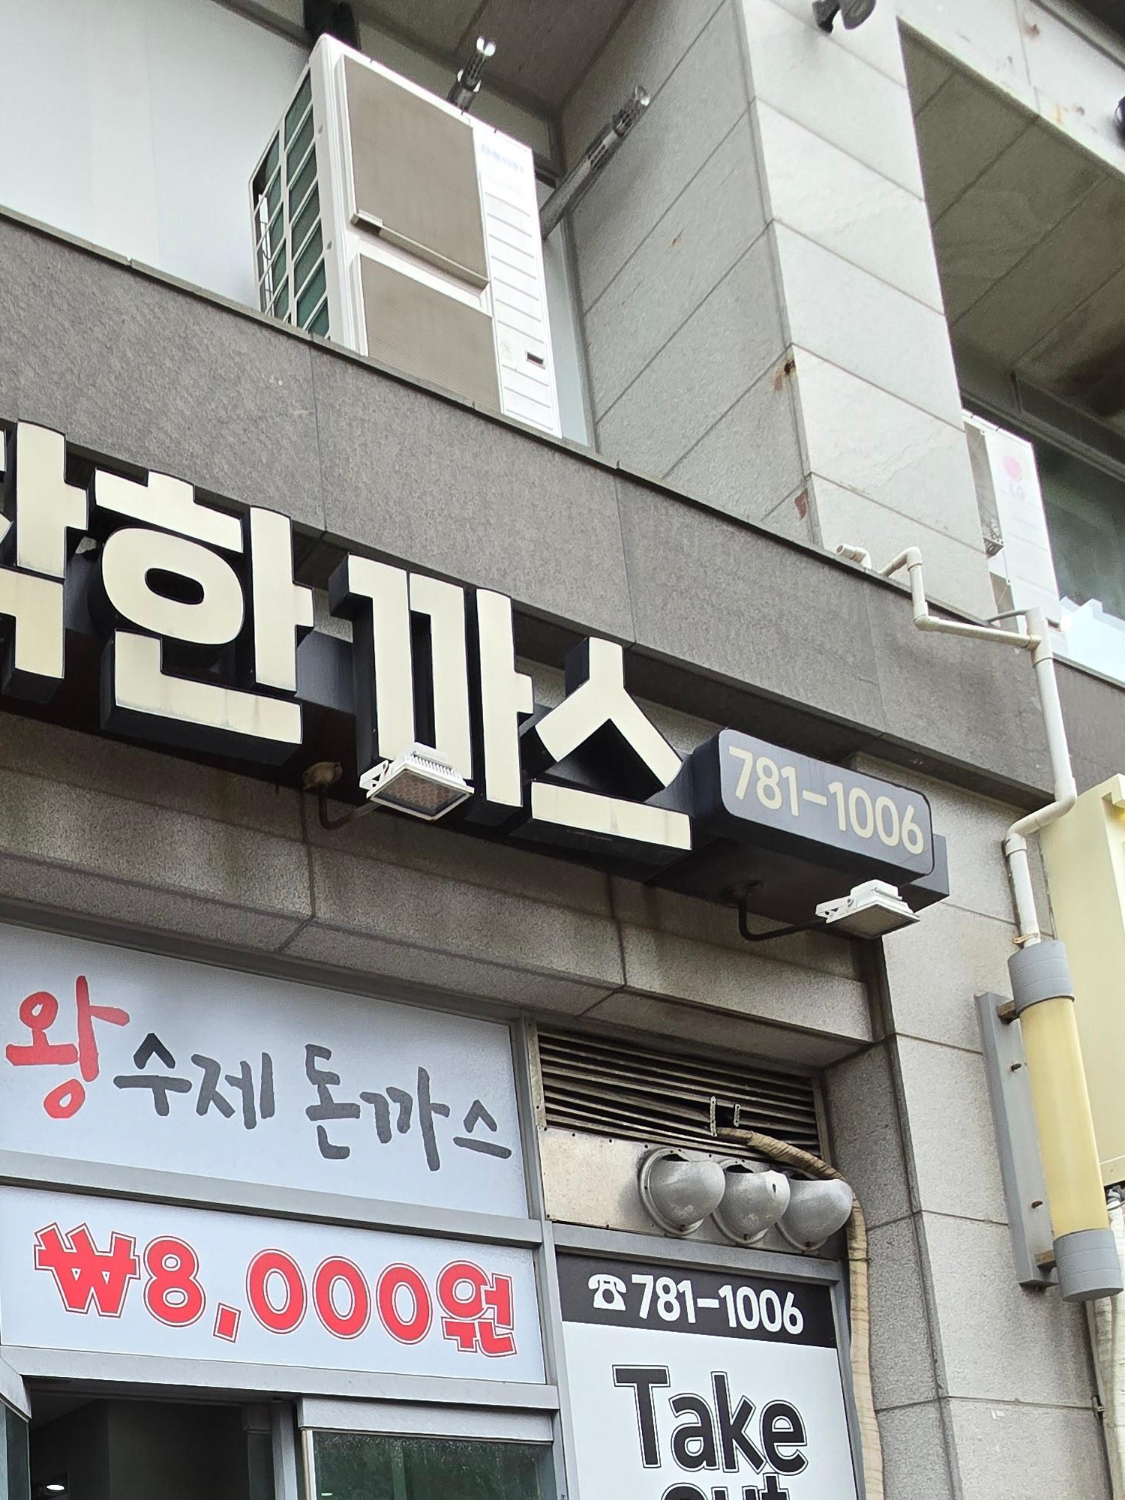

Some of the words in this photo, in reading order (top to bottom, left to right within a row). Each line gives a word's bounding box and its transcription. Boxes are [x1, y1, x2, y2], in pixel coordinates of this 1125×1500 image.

[726, 745, 925, 856] 781-1006
[304, 1043, 512, 1172] 돈까스
[630, 1273, 804, 1336] 781-1006
[611, 1363, 809, 1475] Take
